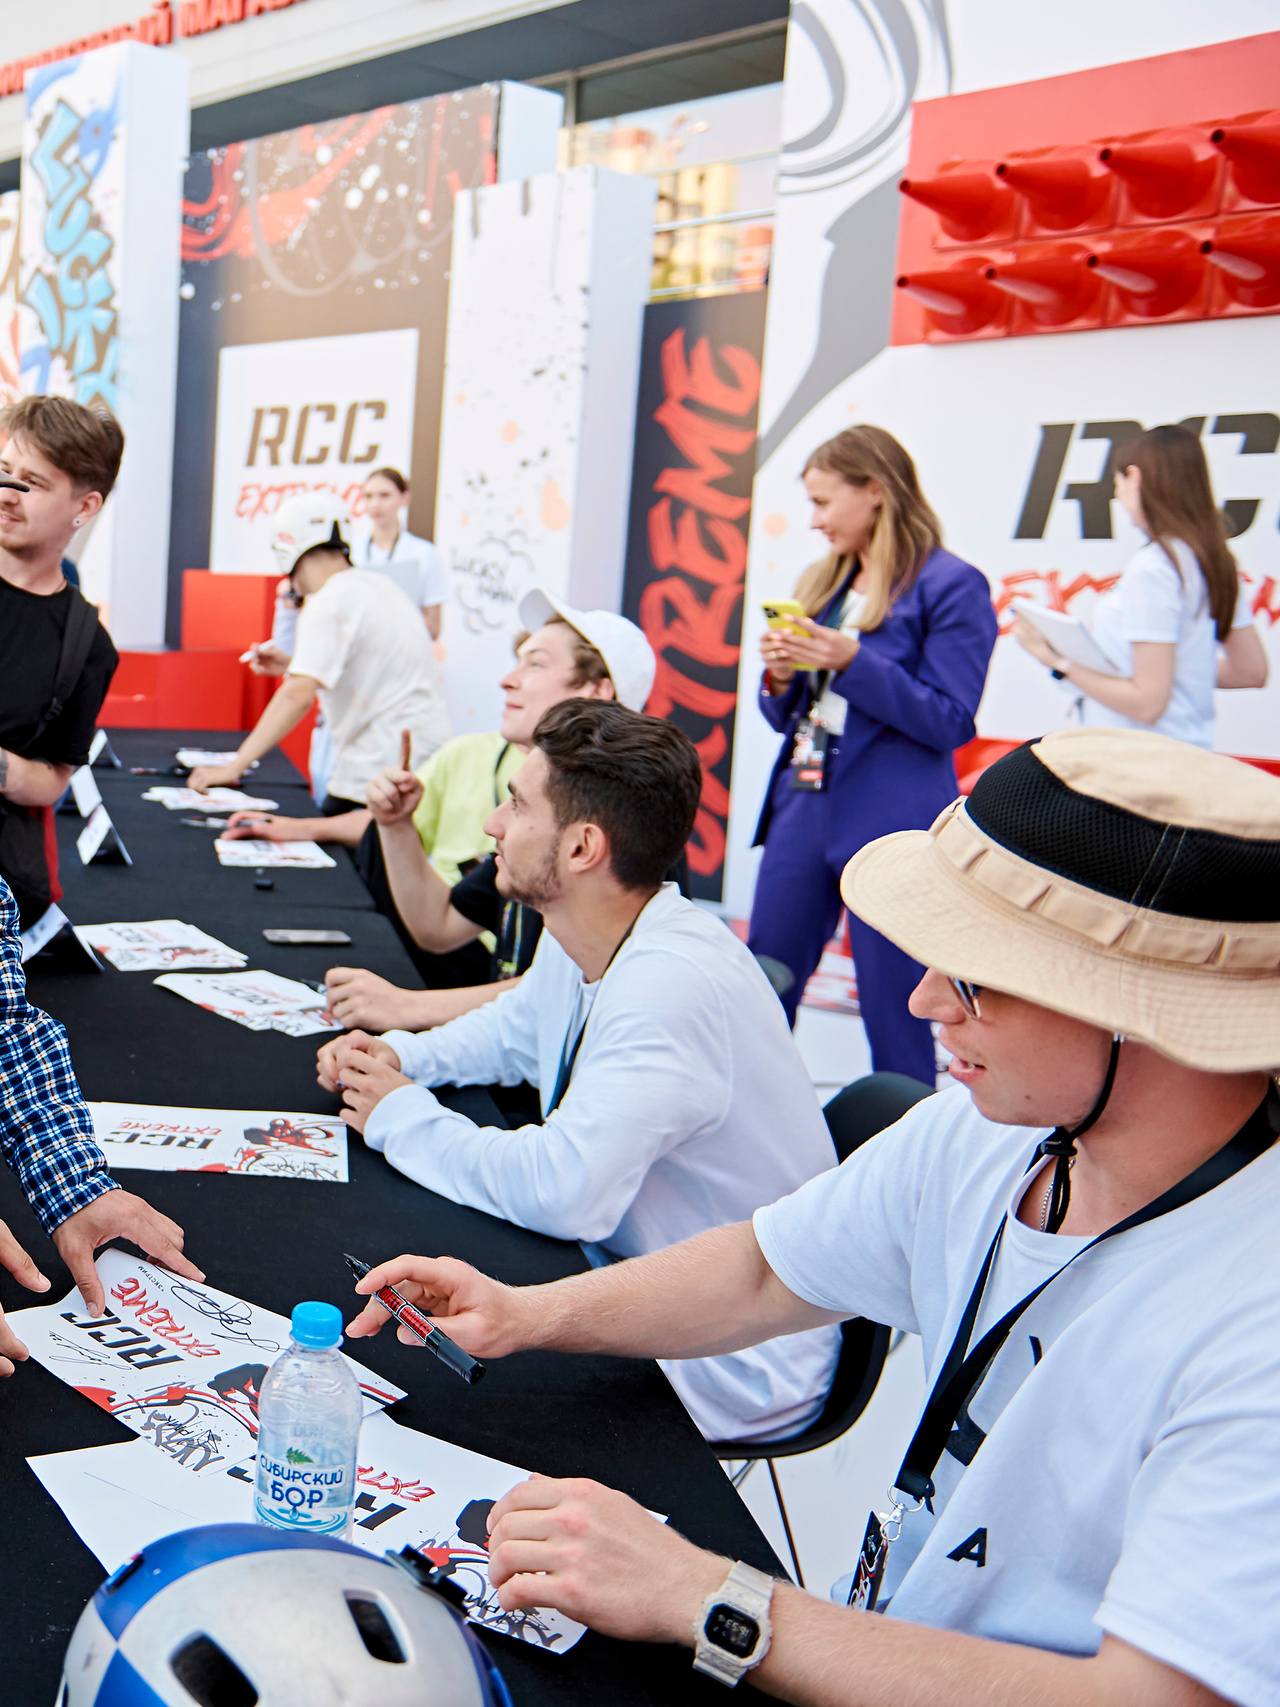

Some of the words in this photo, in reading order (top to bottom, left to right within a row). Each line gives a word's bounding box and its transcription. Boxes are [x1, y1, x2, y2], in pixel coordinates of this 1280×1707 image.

[245, 401, 387, 467] RCC
[103, 1131, 215, 1150] RCC
[110, 1277, 221, 1358] EXTREME
[260, 1454, 343, 1486] СИБИРСКИЙ
[270, 1480, 324, 1509] БОР
